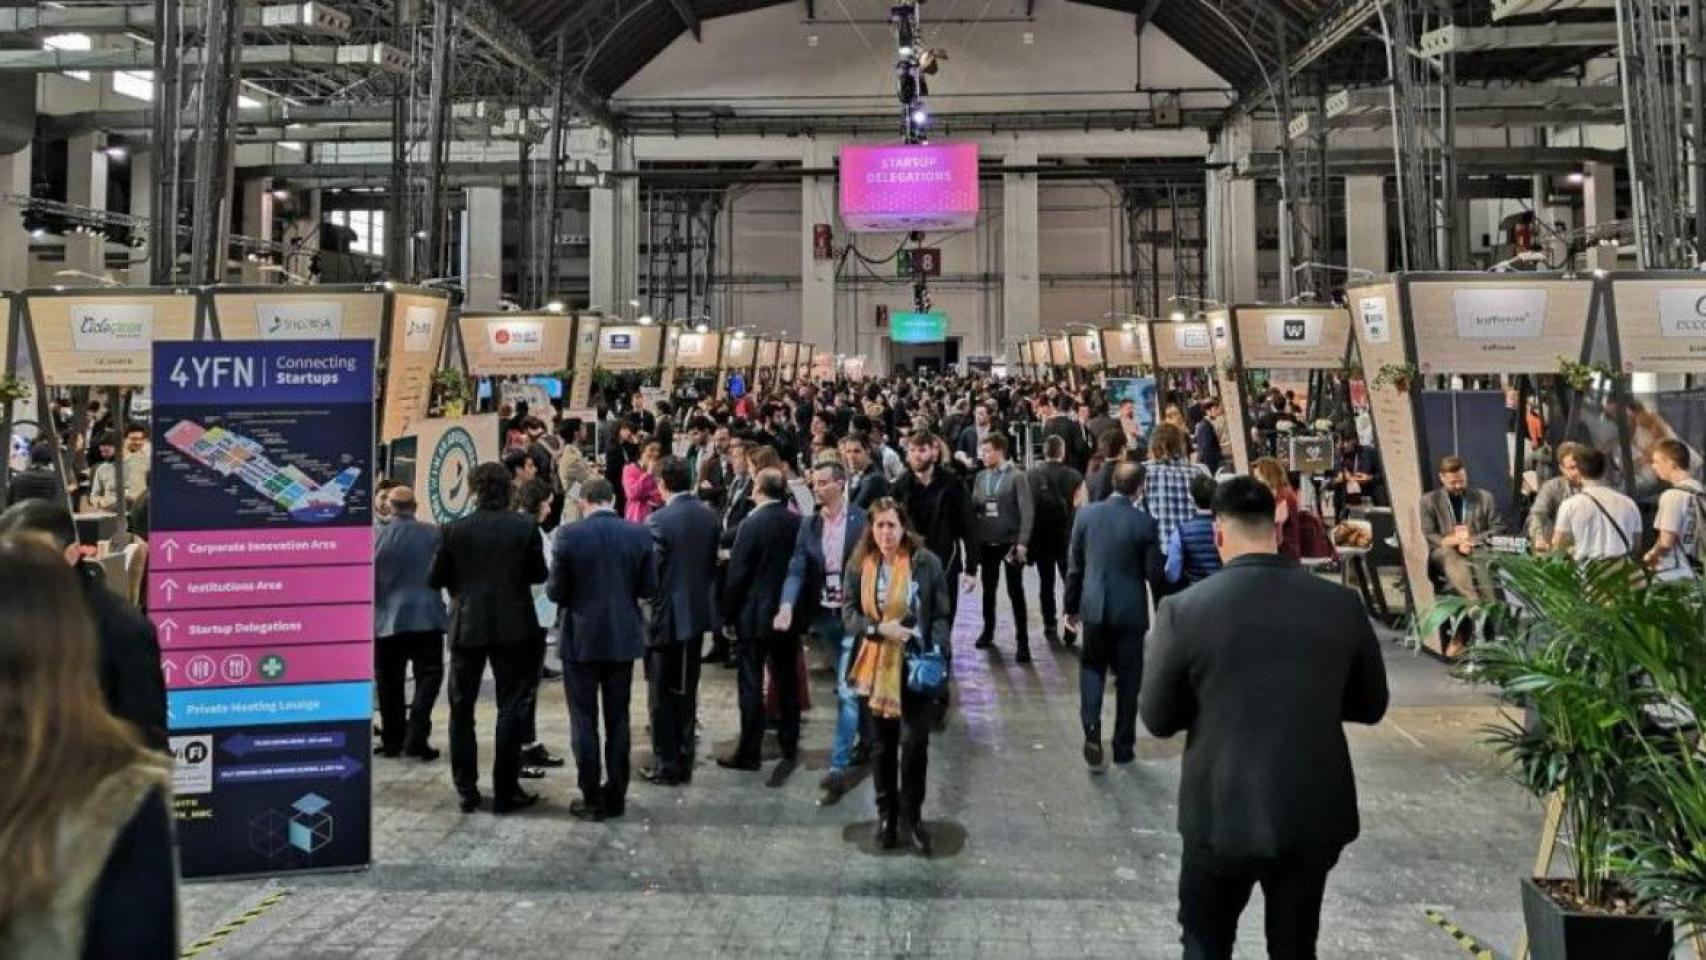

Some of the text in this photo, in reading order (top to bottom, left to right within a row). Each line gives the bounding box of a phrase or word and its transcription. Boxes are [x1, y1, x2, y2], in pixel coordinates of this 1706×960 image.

[866, 171, 953, 183] DELEGATIONS
[922, 253, 933, 270] 8
[1286, 325, 1303, 338] W
[276, 354, 356, 372] Connecting
[170, 356, 254, 388] 4YFN
[276, 371, 339, 387] Startups
[188, 539, 337, 555] Corporate Innovation Area
[187, 580, 283, 593] Institutions Area
[188, 621, 302, 635] Startup Delegations
[186, 699, 321, 715] Private Meeting Lounge
